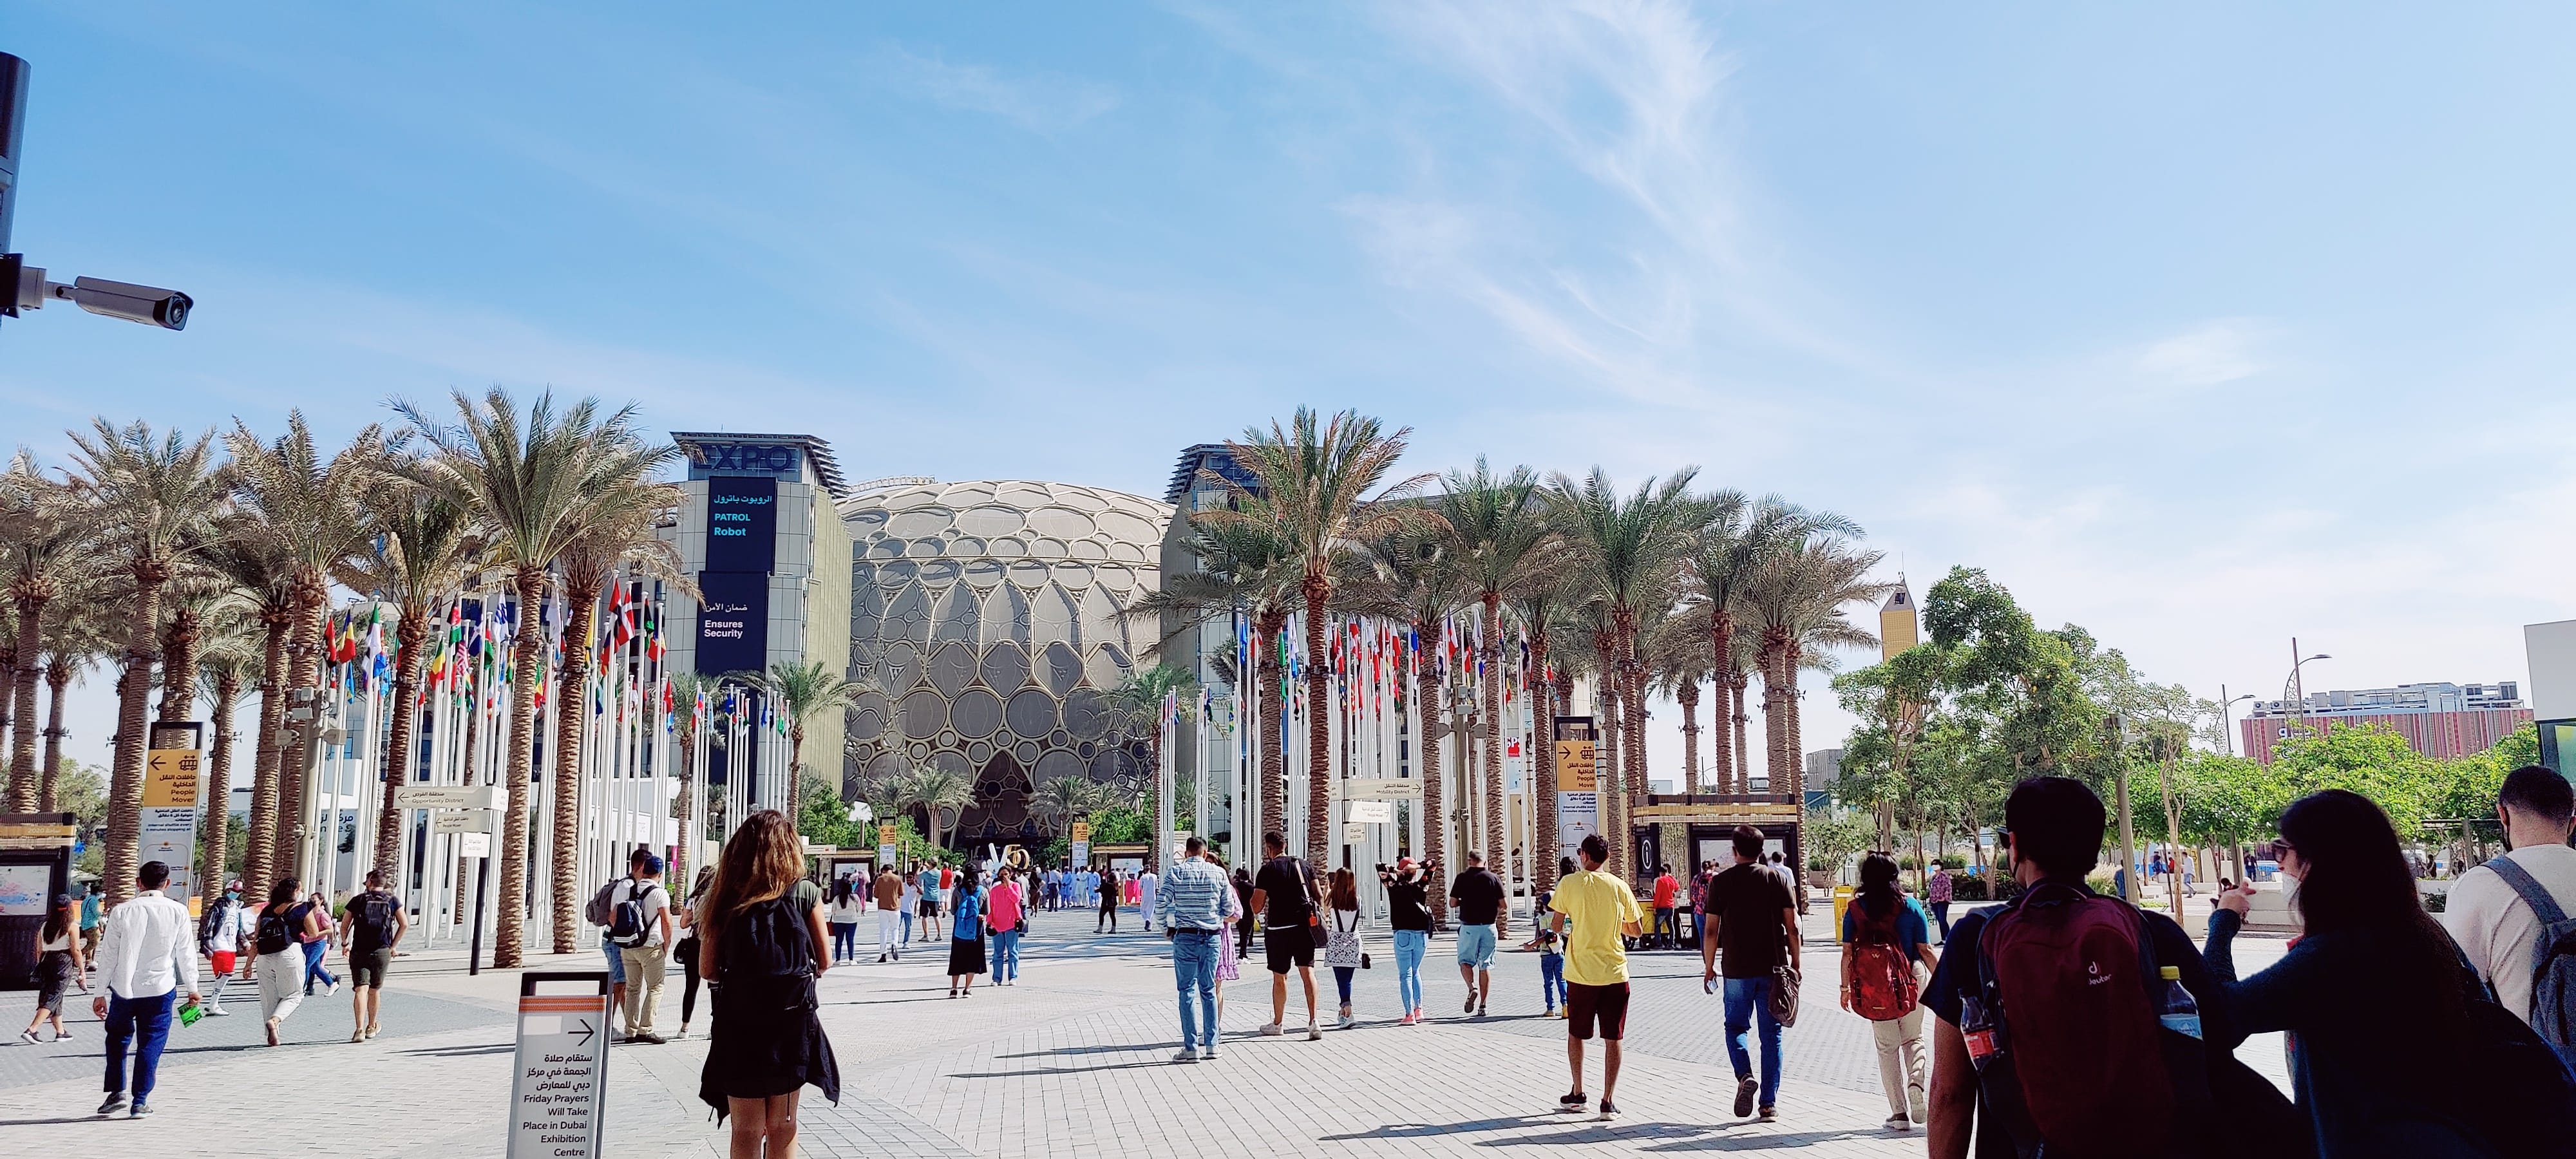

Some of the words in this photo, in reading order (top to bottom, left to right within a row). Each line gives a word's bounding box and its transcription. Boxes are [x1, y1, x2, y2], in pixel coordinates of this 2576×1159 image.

[694, 444, 792, 471] EXPO
[714, 495, 739, 504] باترول
[741, 495, 772, 504] الروبوت
[714, 513, 751, 522] PATROL
[714, 527, 746, 536] Robot
[725, 603, 748, 612] ضمان
[705, 629, 743, 639] Security
[565, 1055, 592, 1064] ستقام
[527, 1068, 545, 1078] مركز
[547, 1068, 562, 1079] في
[536, 1080, 571, 1091] للمعارض
[573, 1082, 590, 1092] دبي
[524, 1095, 553, 1104] Friday
[554, 1095, 589, 1104] Prayers
[560, 1120, 587, 1129] Dubai
[541, 1135, 586, 1143] Exhibition
